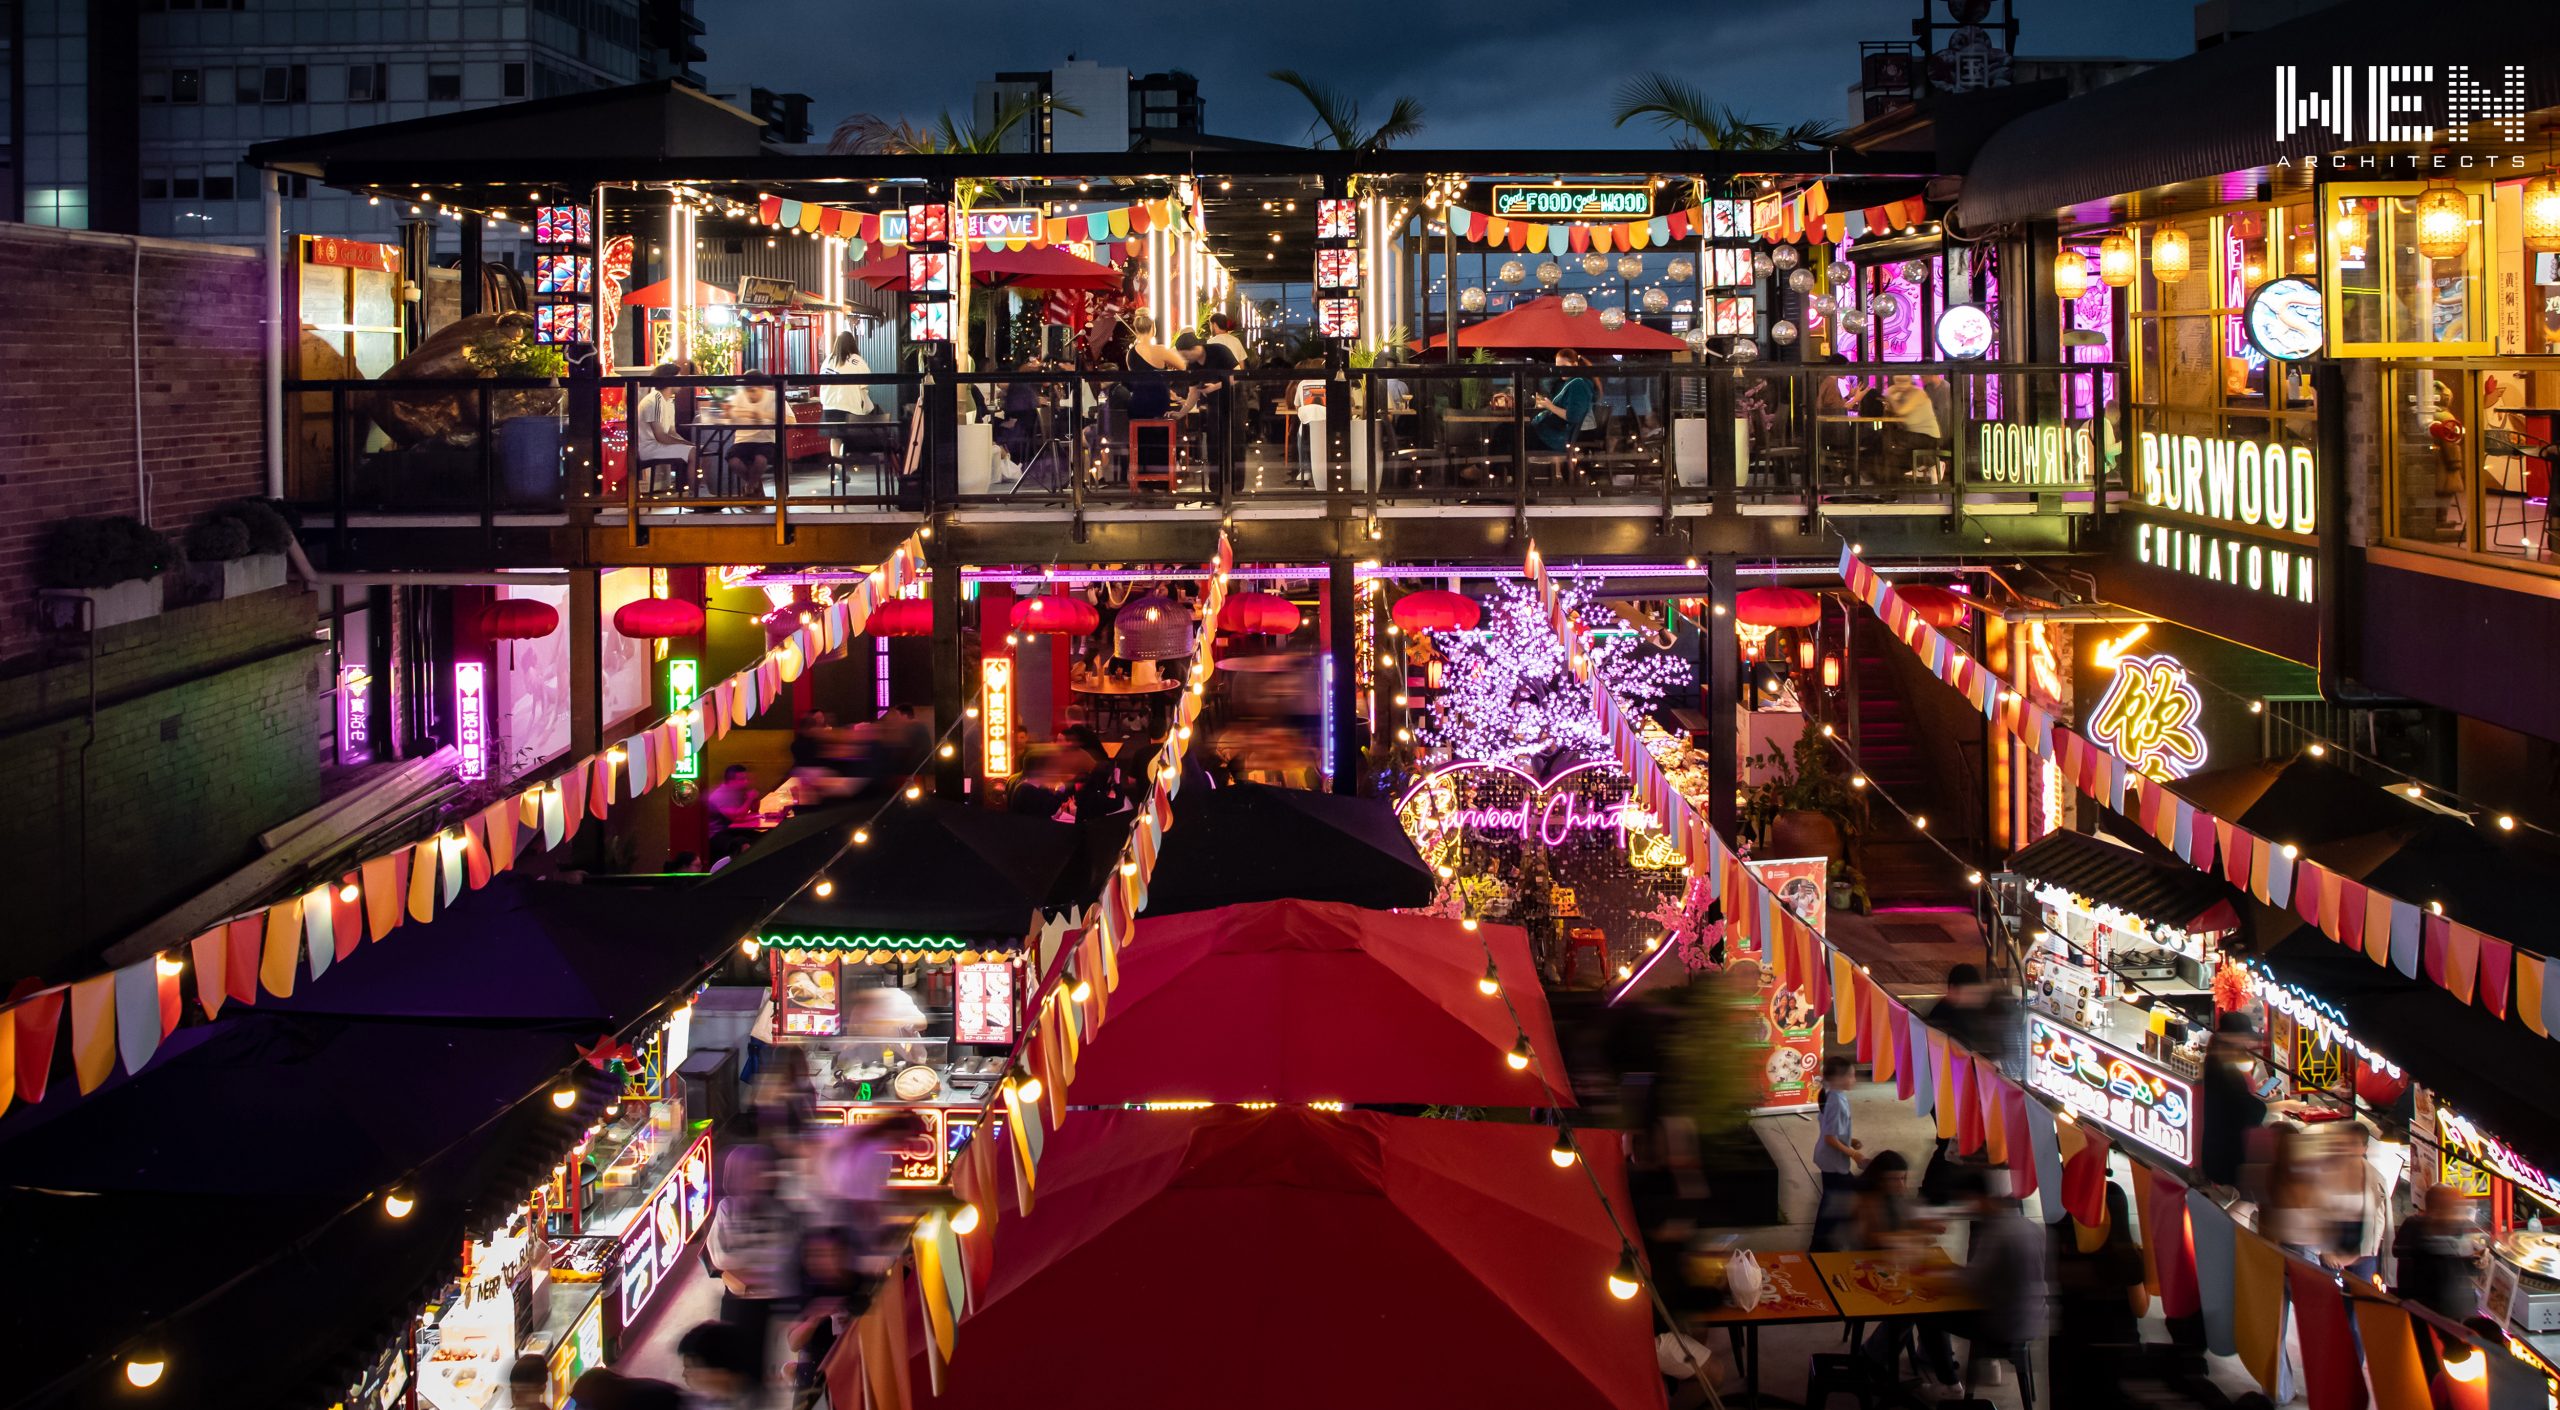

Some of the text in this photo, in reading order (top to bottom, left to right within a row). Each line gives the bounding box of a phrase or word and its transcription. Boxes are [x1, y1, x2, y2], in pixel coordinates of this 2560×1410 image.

[1500, 188, 1648, 213] Good FOOD Good MOOD
[2141, 431, 2316, 535] BURWOOD
[2139, 523, 2313, 604] CHINATOWN
